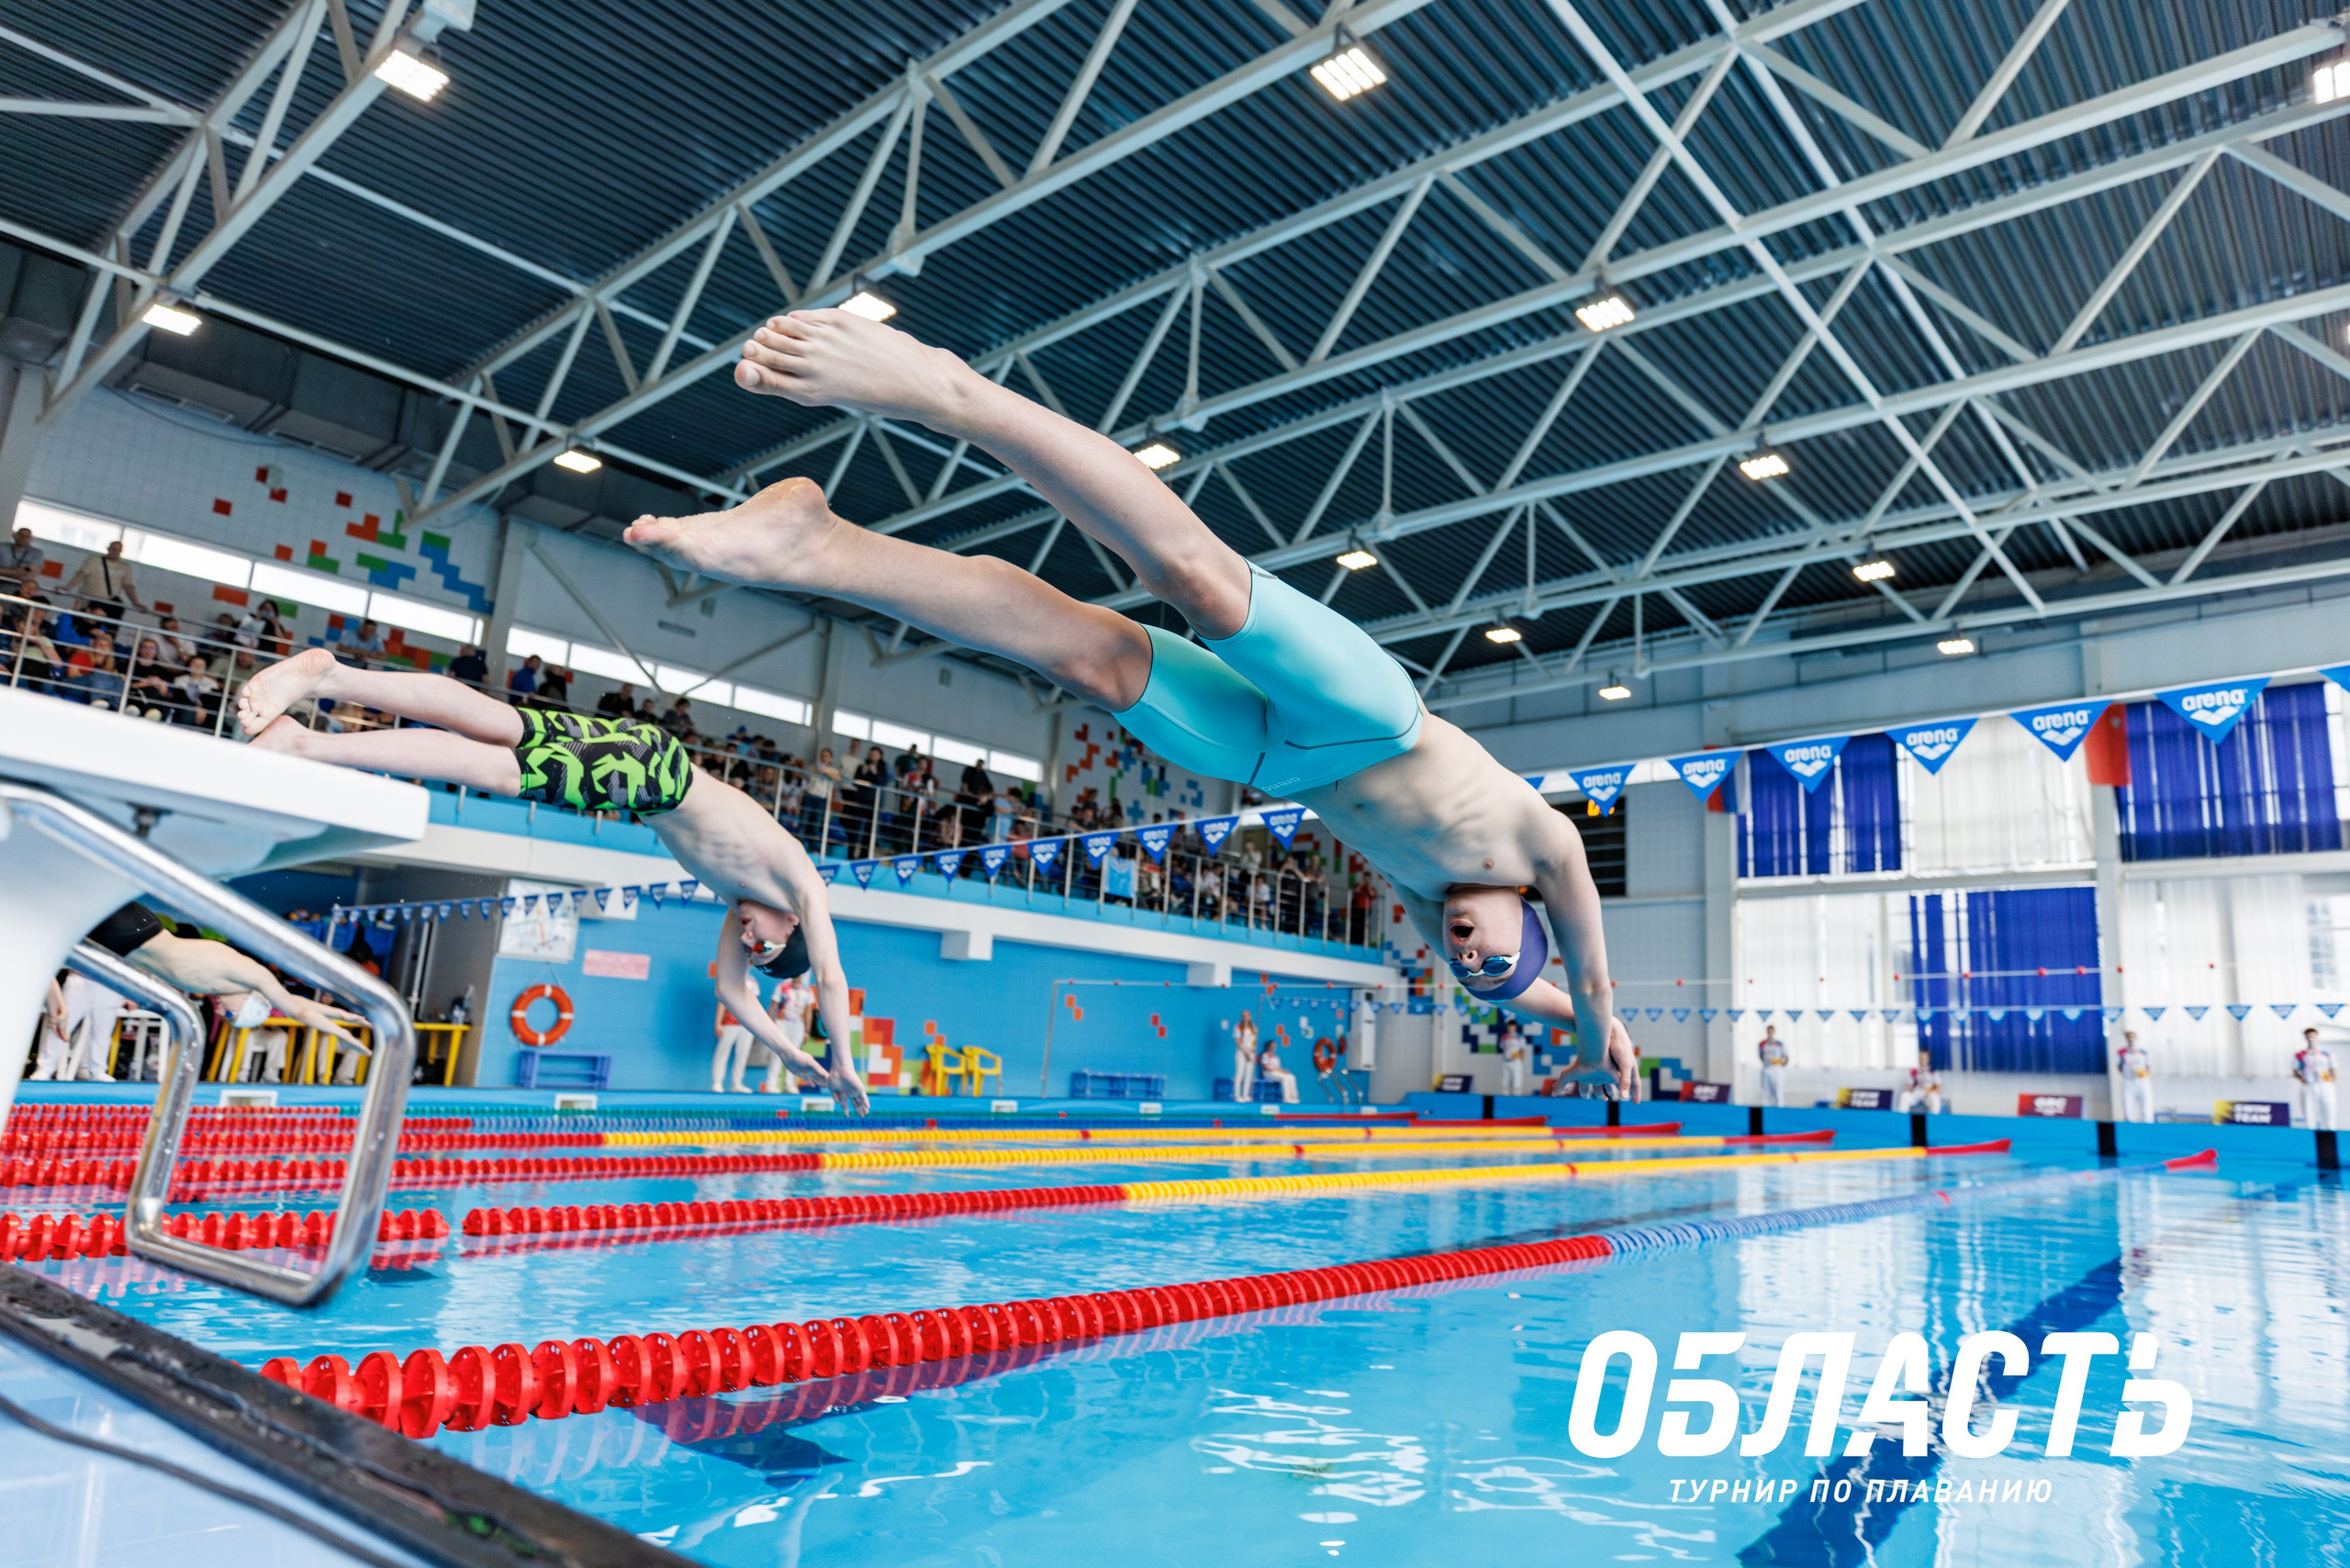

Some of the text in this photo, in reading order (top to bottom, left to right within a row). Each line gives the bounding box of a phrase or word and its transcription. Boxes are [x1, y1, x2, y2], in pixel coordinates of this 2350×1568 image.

[2182, 689, 2245, 710] arena
[2032, 710, 2088, 731] arena
[1906, 728, 1958, 746] arena
[1785, 745, 1831, 764] arena
[1682, 758, 1725, 775] arena
[1262, 777, 1301, 791] arena
[1583, 772, 1622, 789] arena
[1270, 813, 1298, 826] arena
